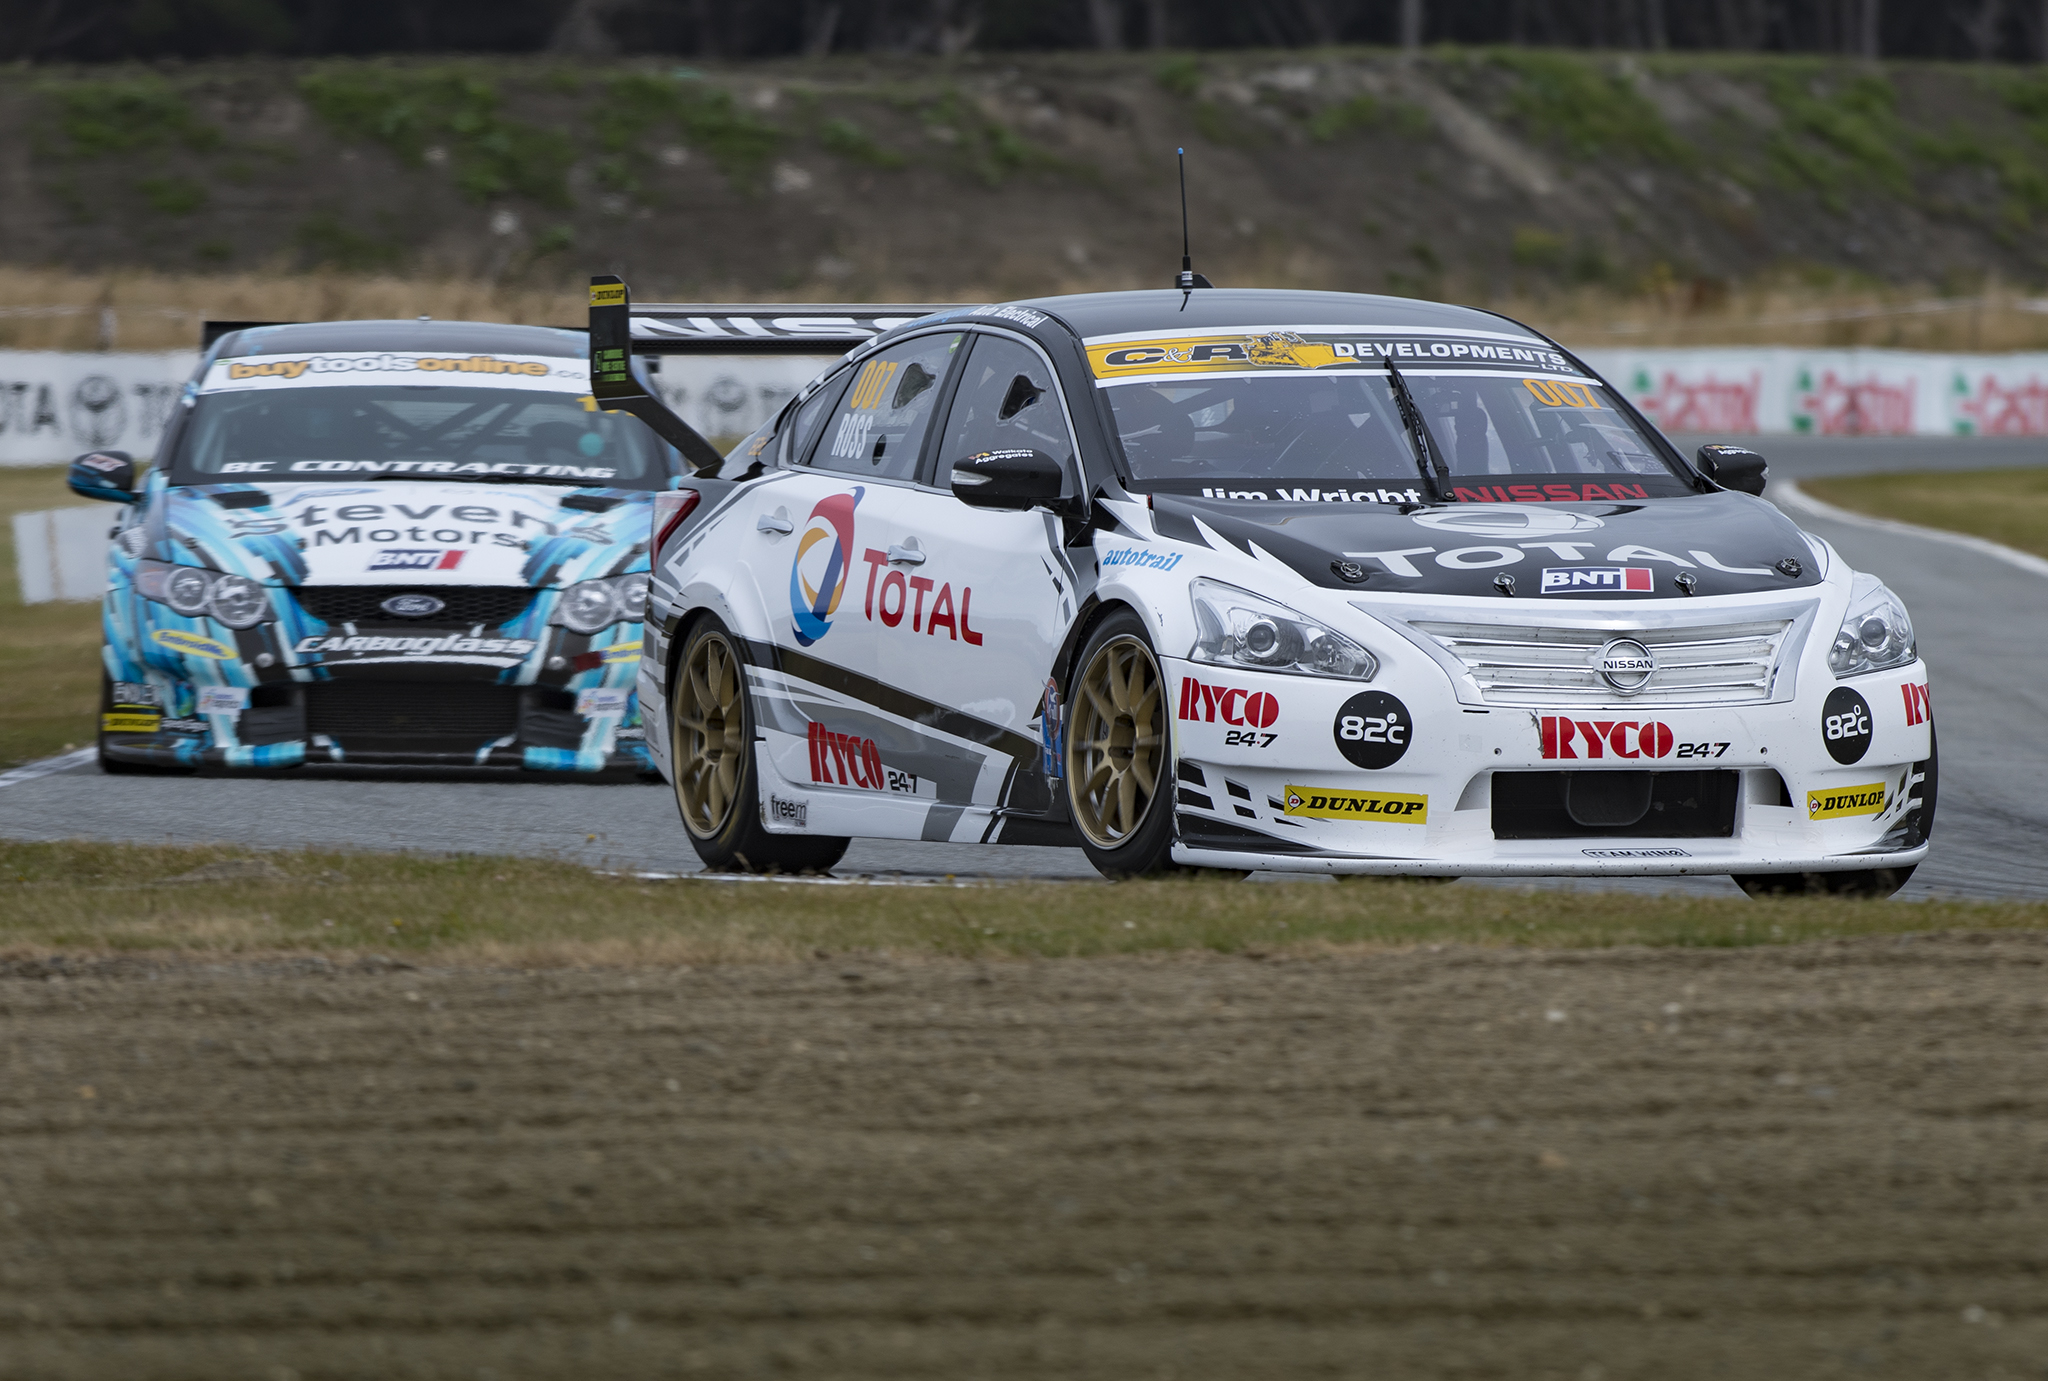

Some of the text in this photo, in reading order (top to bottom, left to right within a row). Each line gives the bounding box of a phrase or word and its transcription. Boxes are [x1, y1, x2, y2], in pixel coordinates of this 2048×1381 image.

[994, 306, 1049, 329] Electrical
[1333, 342, 1567, 366] DEVELOPMENTS
[1541, 363, 1574, 373] LTD
[850, 360, 899, 410] 007
[1522, 378, 1602, 410] 007
[830, 412, 874, 460] ROSS
[219, 460, 617, 479] BC CONTRACTING
[975, 452, 1034, 464] Aggregates
[1452, 483, 1649, 503] NISSAN
[314, 525, 517, 548] Motors
[375, 551, 440, 567] BNT
[1102, 546, 1184, 572] autotrail
[1342, 541, 1775, 578] TOTAL
[1545, 569, 1621, 587] BNT
[862, 547, 983, 647] TOTAL
[1603, 660, 1653, 669] NISSAN
[1178, 676, 1280, 729] RYCO
[1541, 715, 1674, 760] RYCO
[807, 721, 885, 791] RYCO
[770, 794, 808, 819] freem
[1307, 795, 1425, 816] DUNLOP
[1823, 790, 1885, 811] DUNLOP
